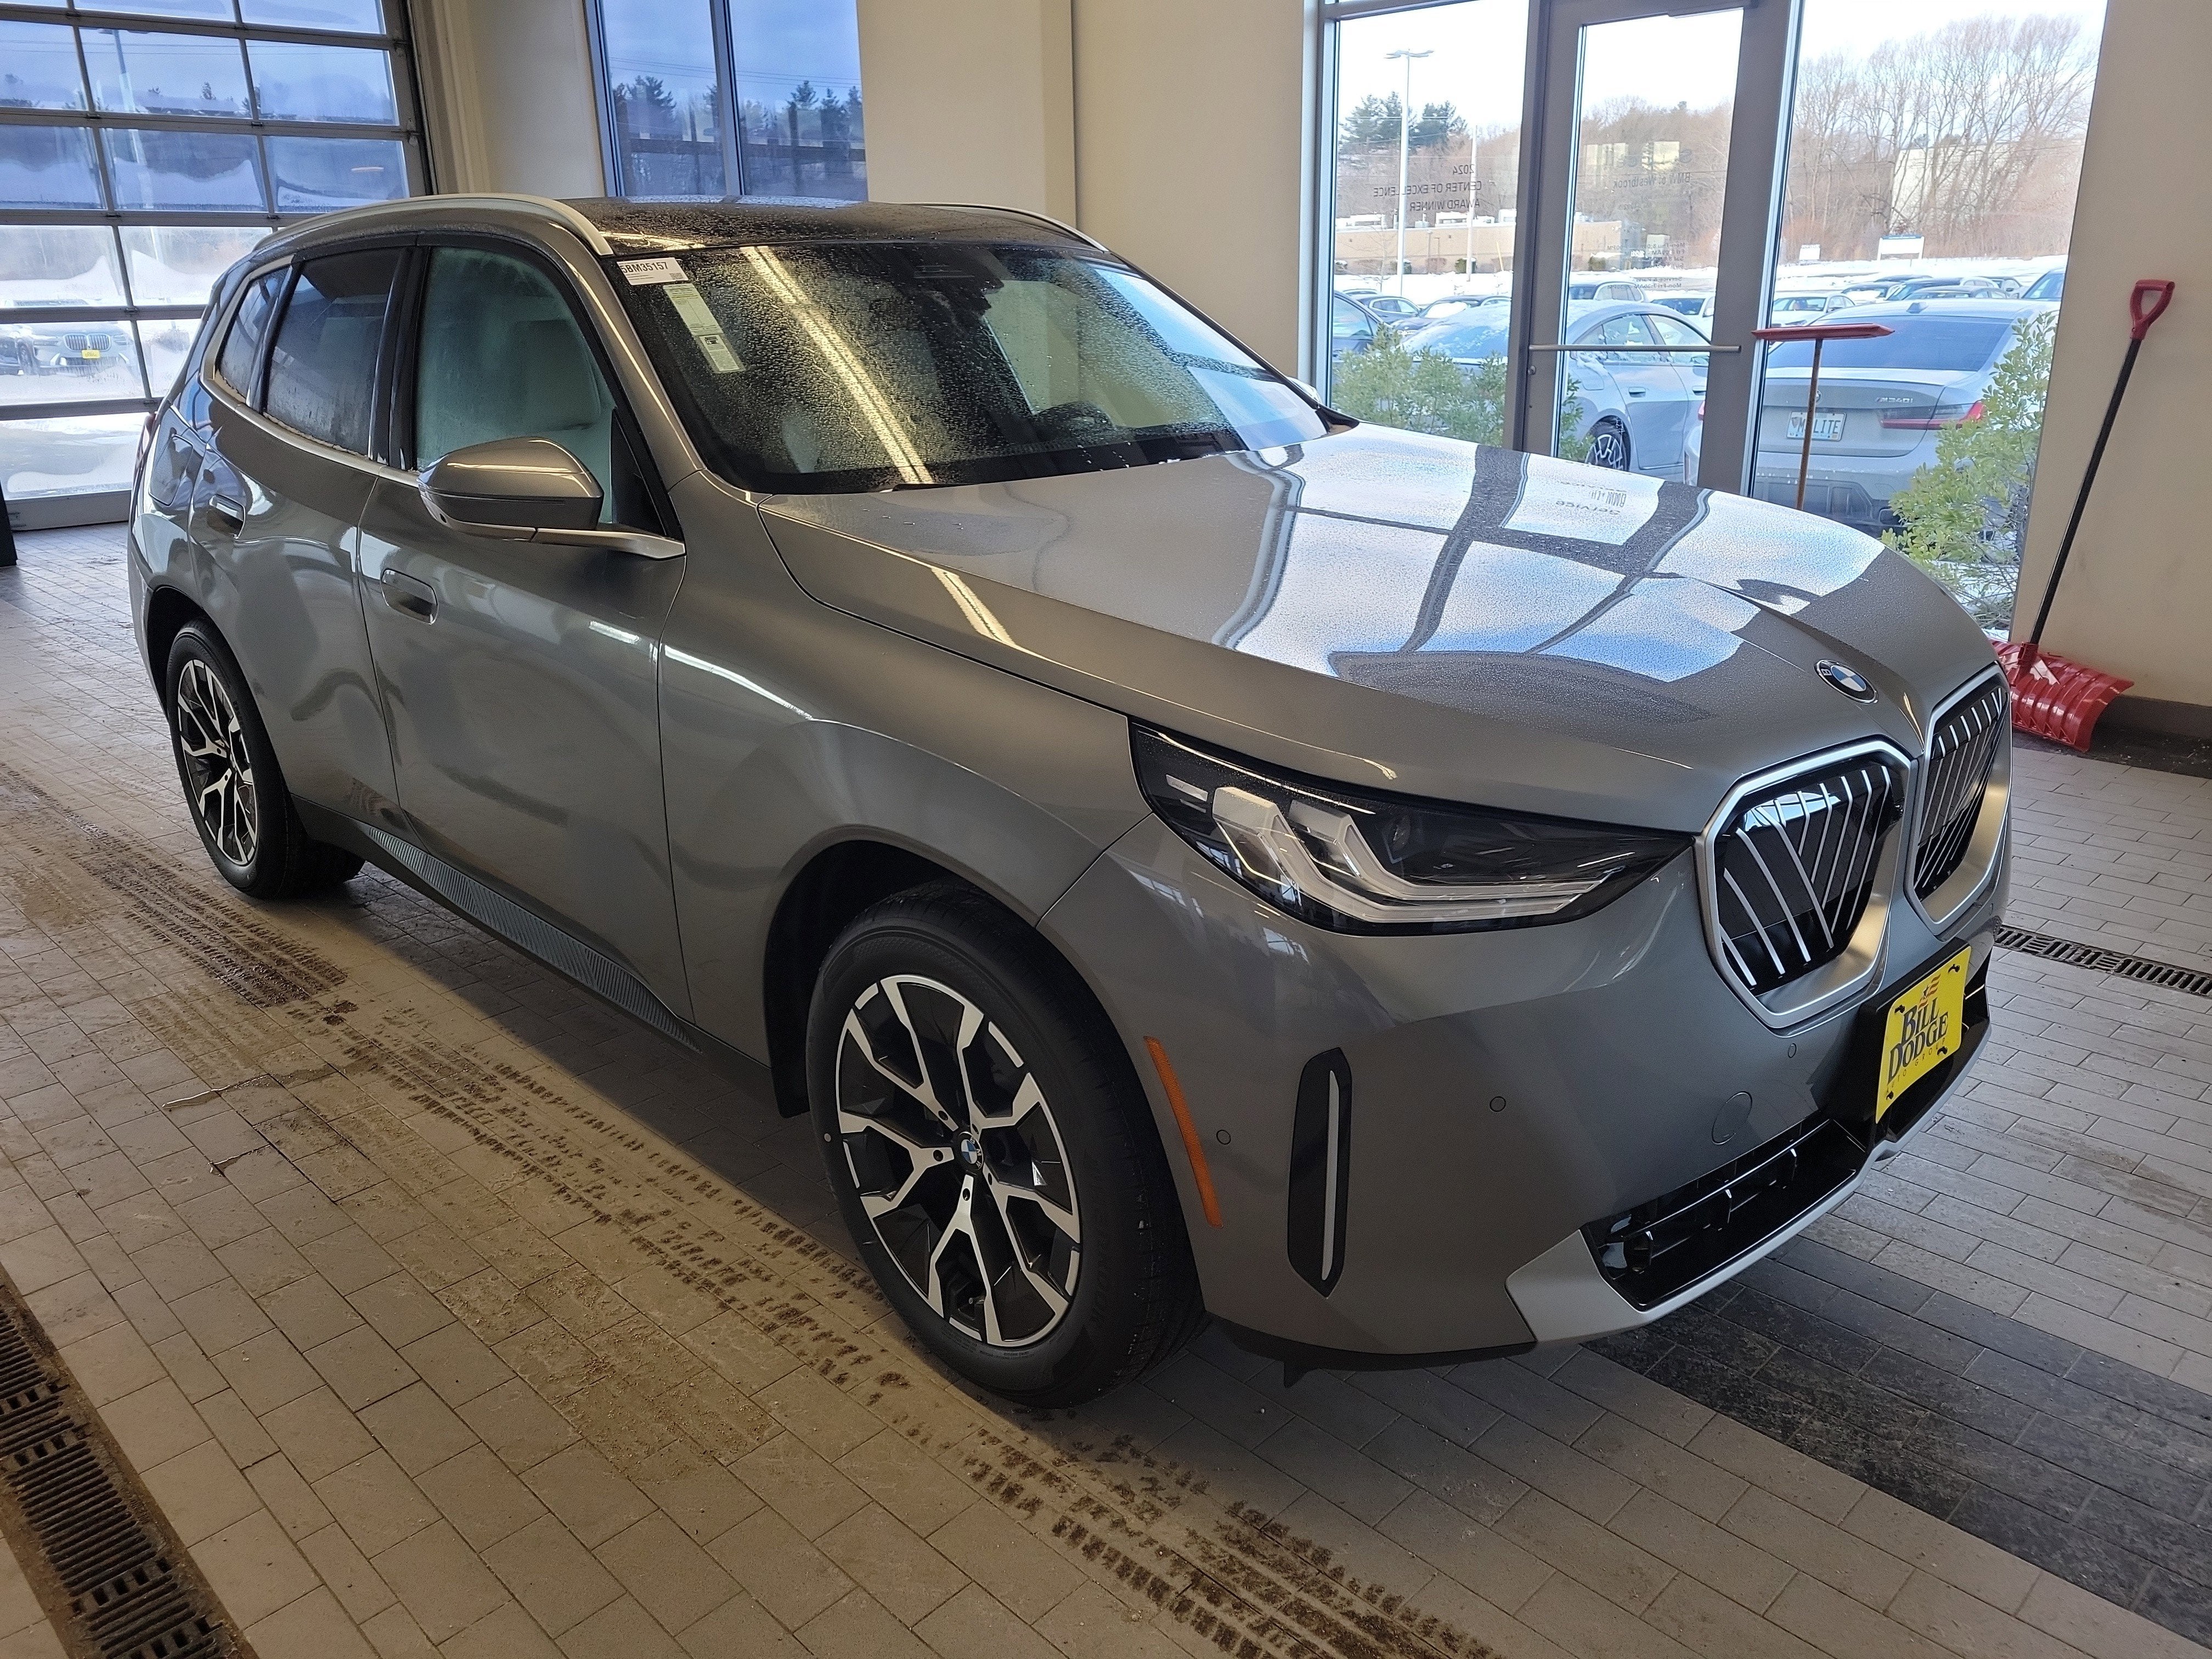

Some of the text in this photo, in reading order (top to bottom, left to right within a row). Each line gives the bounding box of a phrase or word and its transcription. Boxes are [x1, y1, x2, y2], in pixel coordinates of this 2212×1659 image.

[1798, 416, 1841, 434] MLITE
[1901, 996, 1940, 1044] BILL
[1886, 1012, 1949, 1086] DODGE
[1915, 1036, 1945, 1066] GROUP
